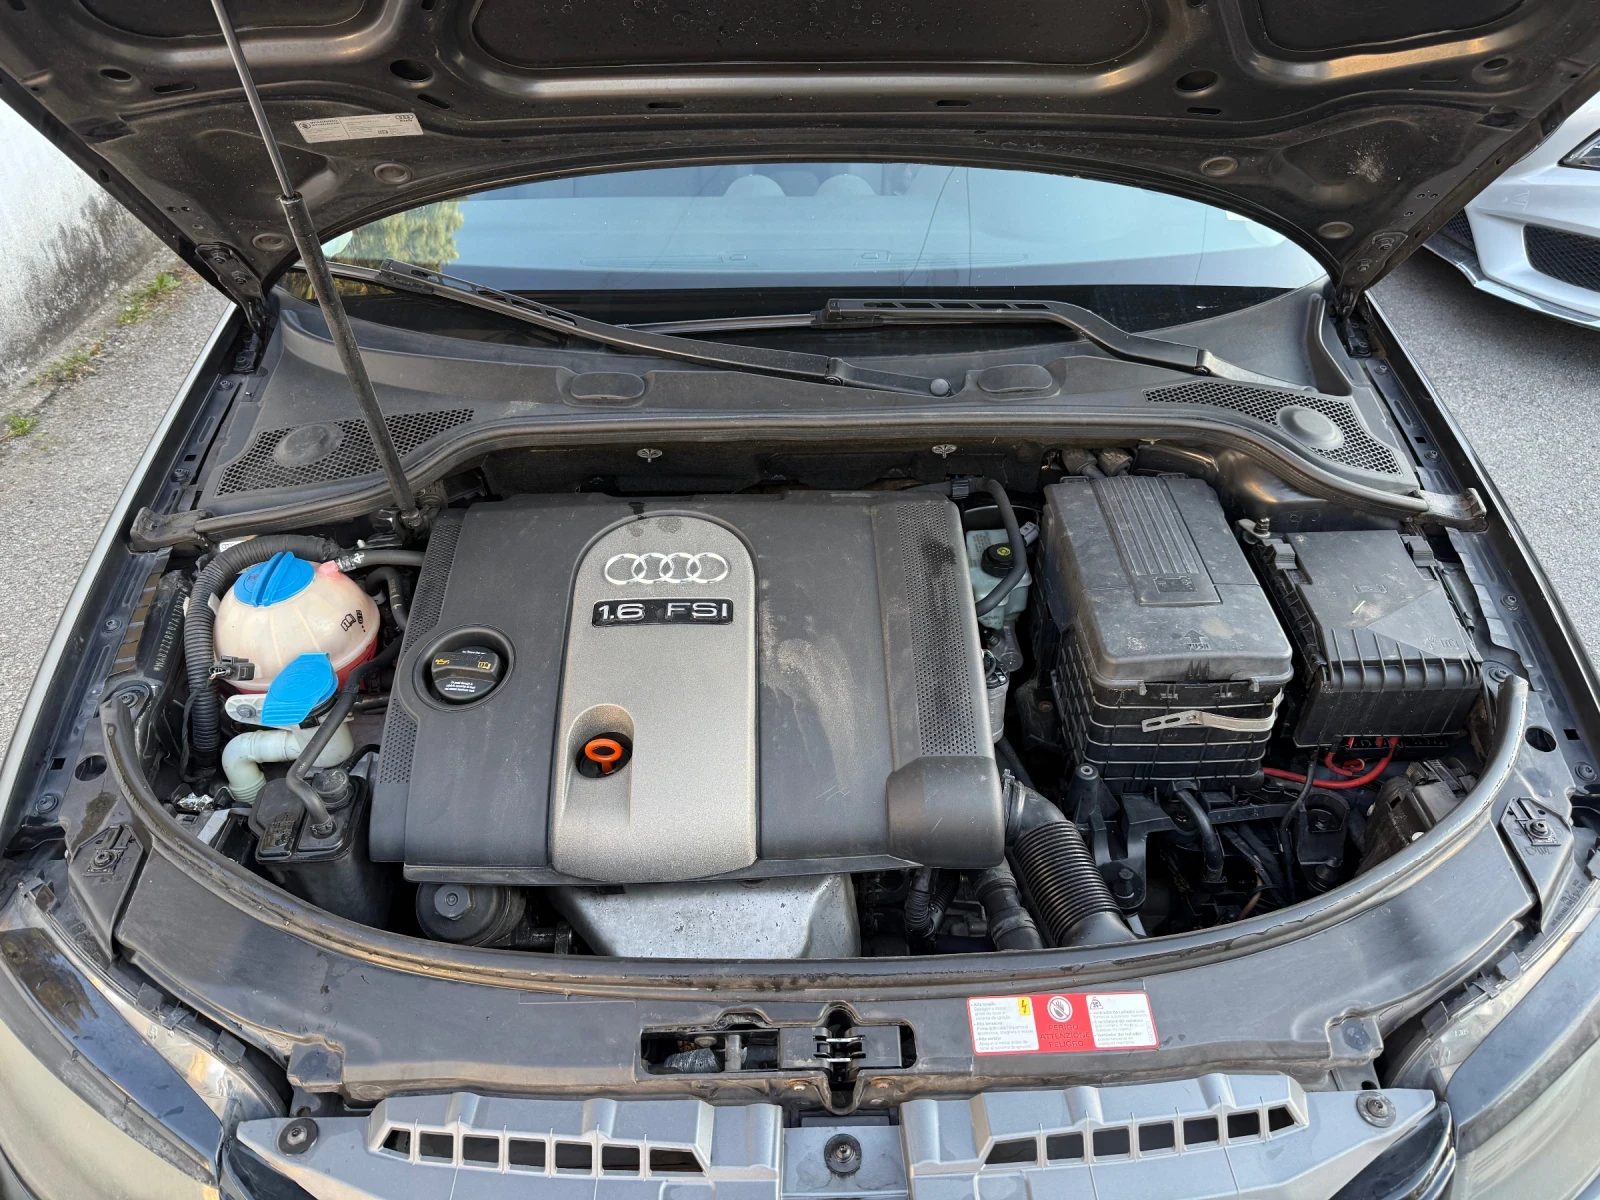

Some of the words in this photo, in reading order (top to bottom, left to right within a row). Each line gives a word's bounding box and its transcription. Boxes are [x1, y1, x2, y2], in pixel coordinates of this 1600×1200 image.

[599, 603, 645, 620] 1.6
[665, 602, 729, 620] FSI
[1040, 1032, 1091, 1040] ATTENZIONE
[1048, 1041, 1084, 1049] PELIGRO
